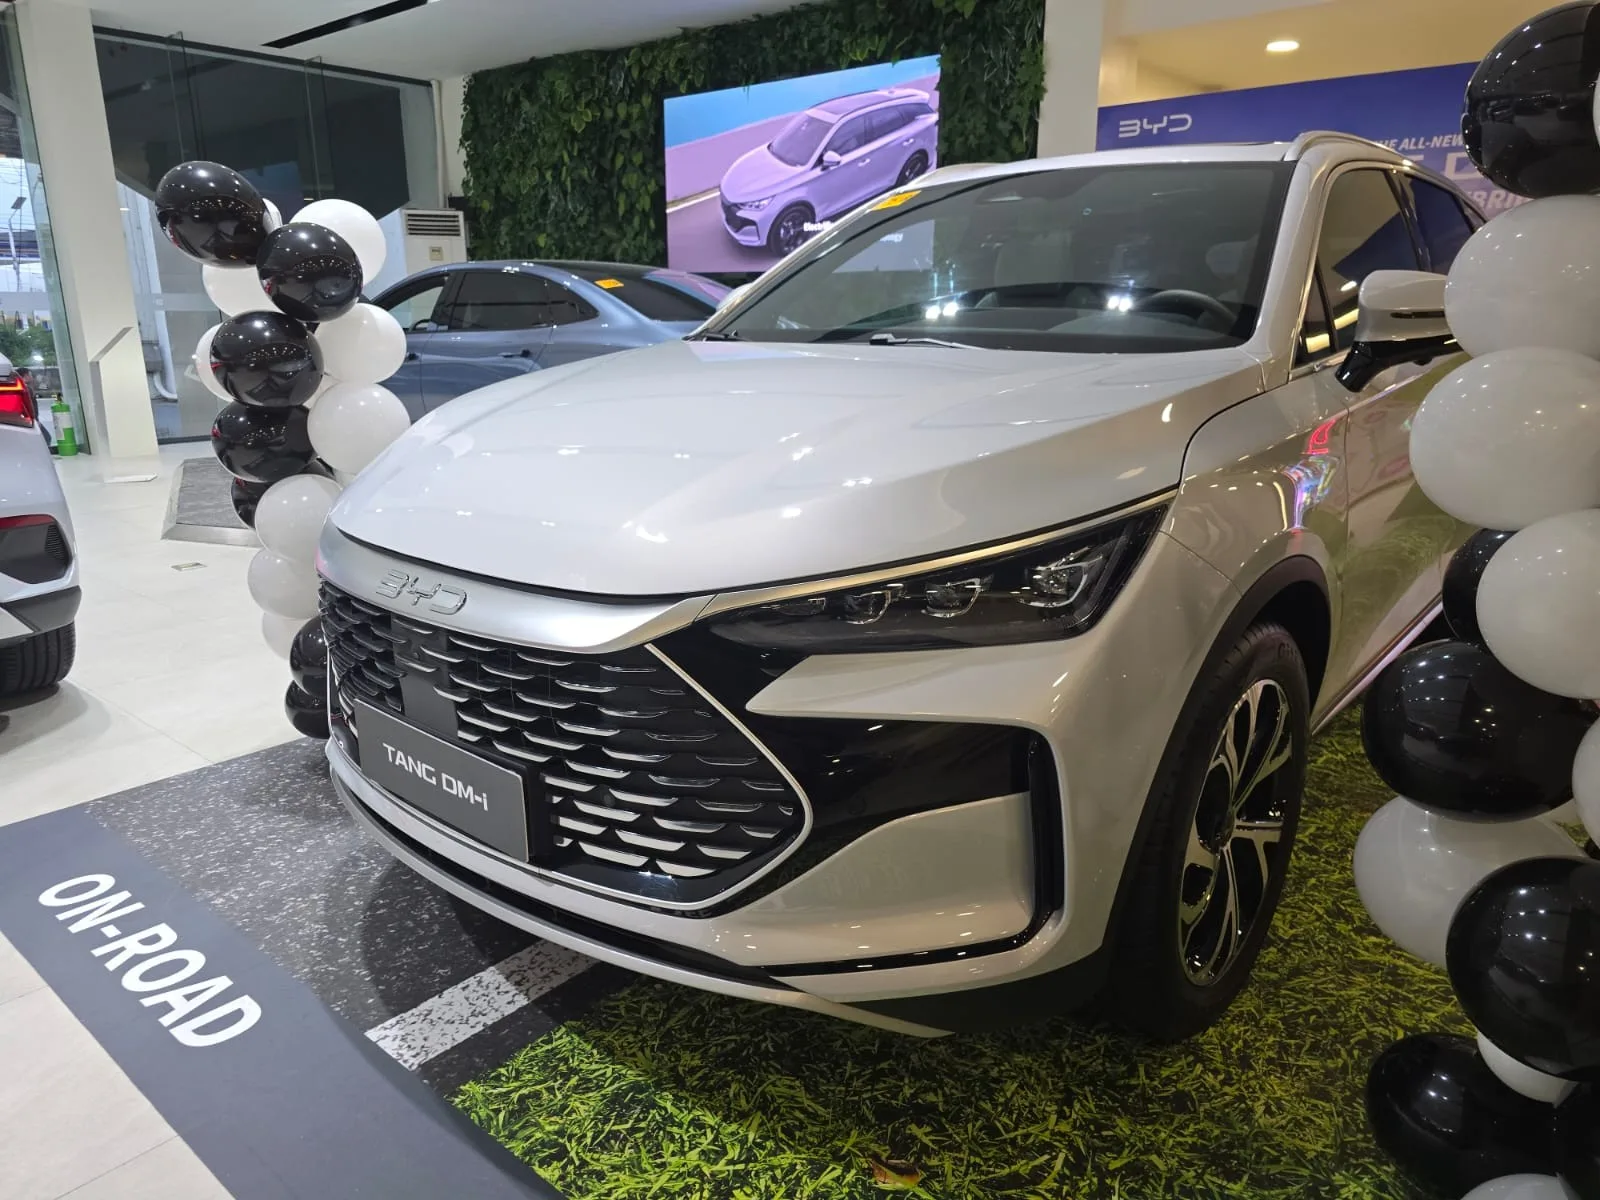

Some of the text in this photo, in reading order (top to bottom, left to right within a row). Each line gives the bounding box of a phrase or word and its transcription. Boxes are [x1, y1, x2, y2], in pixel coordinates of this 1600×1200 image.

[1118, 113, 1193, 138] BYD
[376, 569, 468, 615] BYD
[383, 742, 488, 811] TANG DM-i
[38, 873, 262, 1047] ON-ROAD
